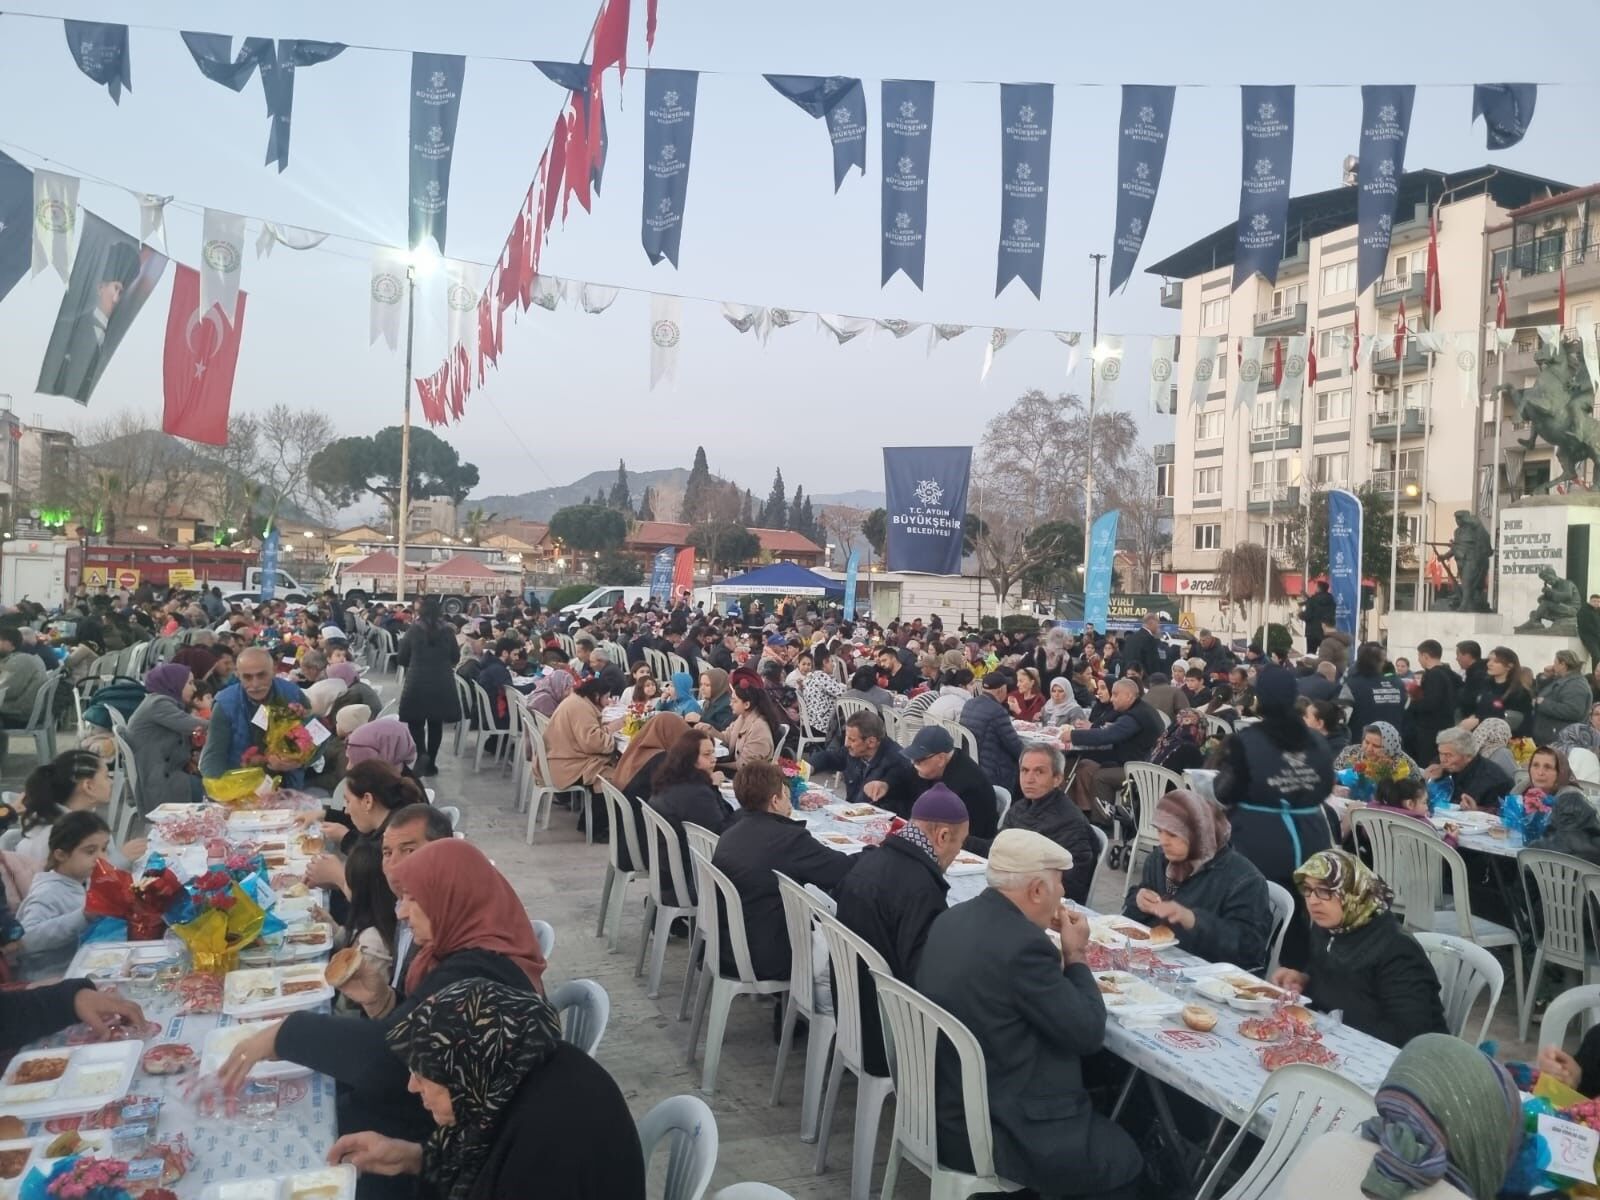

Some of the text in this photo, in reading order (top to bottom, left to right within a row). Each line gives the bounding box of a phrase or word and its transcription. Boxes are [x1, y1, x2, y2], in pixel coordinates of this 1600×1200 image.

[926, 508, 950, 516] AYDIN
[893, 514, 960, 529] BÜYÜKŞEHİR
[1503, 520, 1523, 530] NE
[907, 526, 951, 537] BELEDİYESİ
[1503, 534, 1551, 545] MUTLU
[1502, 545, 1563, 559] TÜRKÜM
[1502, 562, 1552, 575] DİYEN
[1107, 606, 1147, 616] AZANLAR
